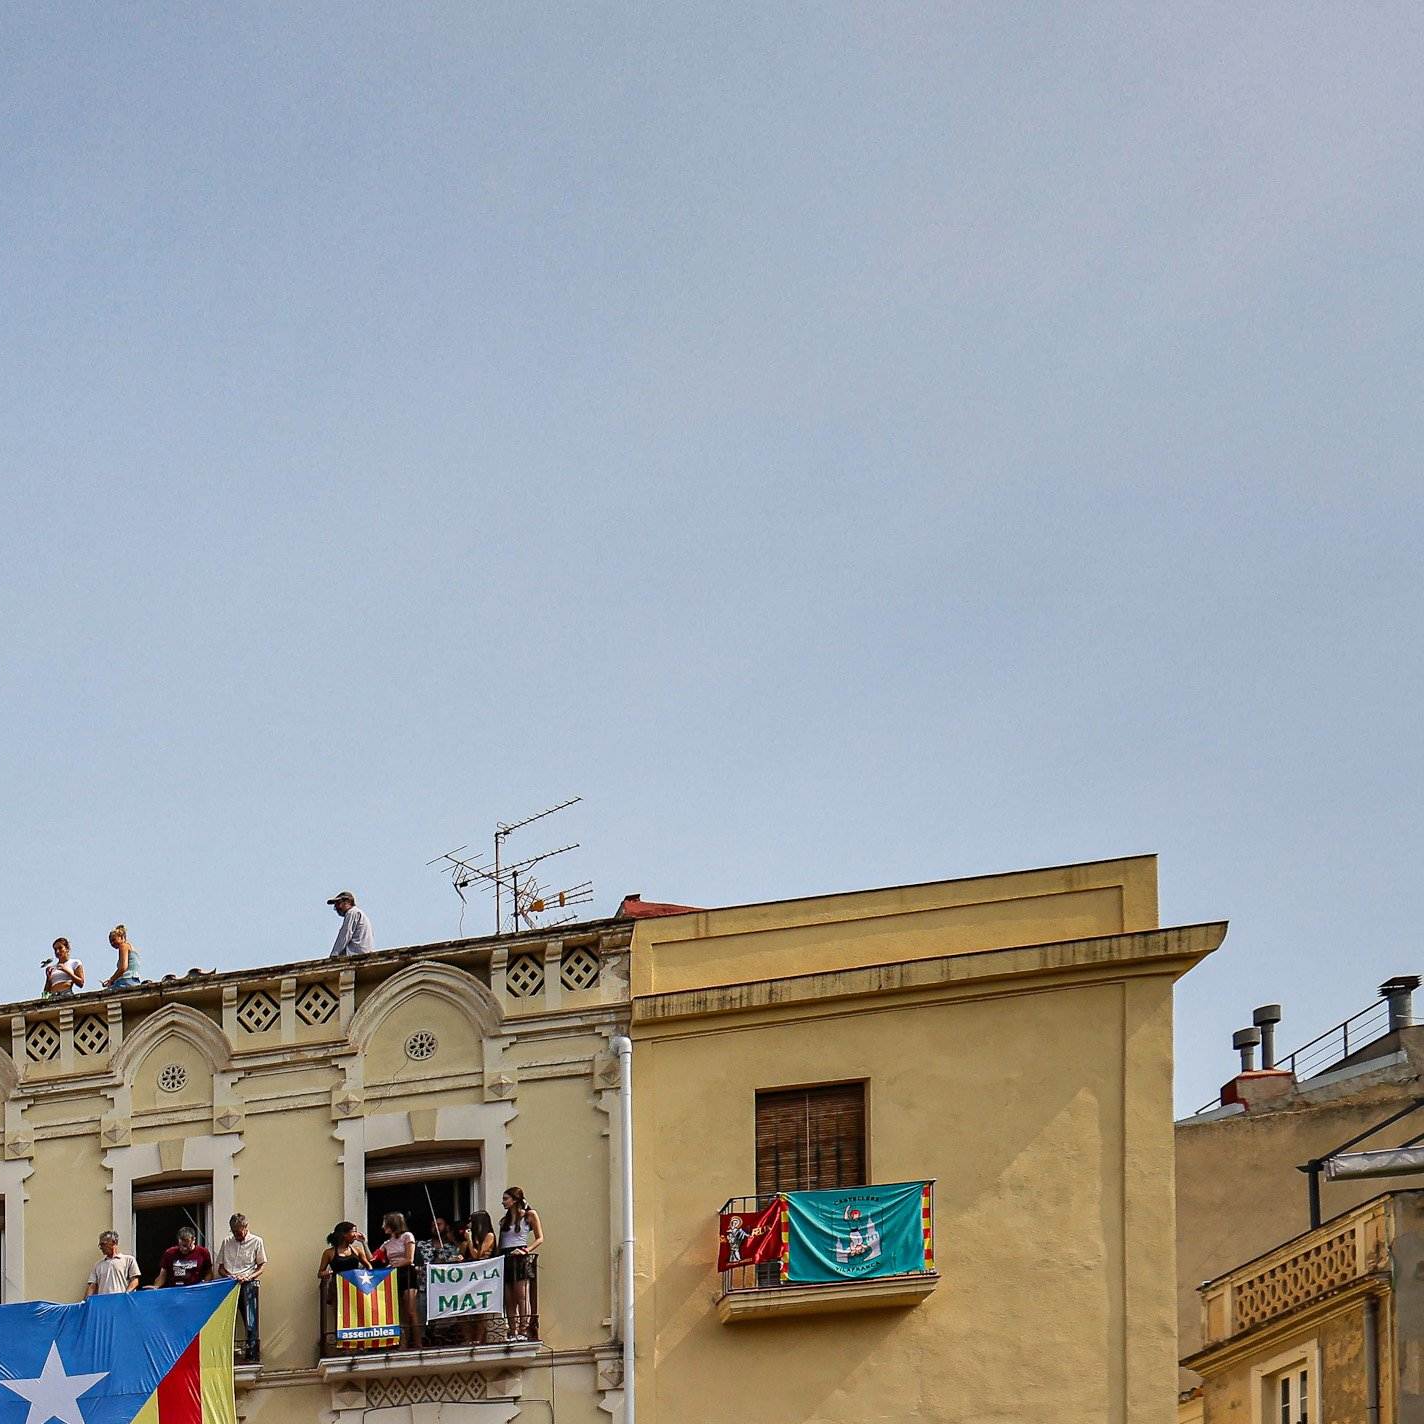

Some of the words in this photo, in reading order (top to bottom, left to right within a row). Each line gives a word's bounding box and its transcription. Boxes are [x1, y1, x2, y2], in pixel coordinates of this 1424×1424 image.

[431, 1268, 463, 1284] NO
[469, 1272, 478, 1281] A
[483, 1269, 500, 1280] LA
[438, 1291, 492, 1312] MAT
[342, 1328, 395, 1340] assemblea
